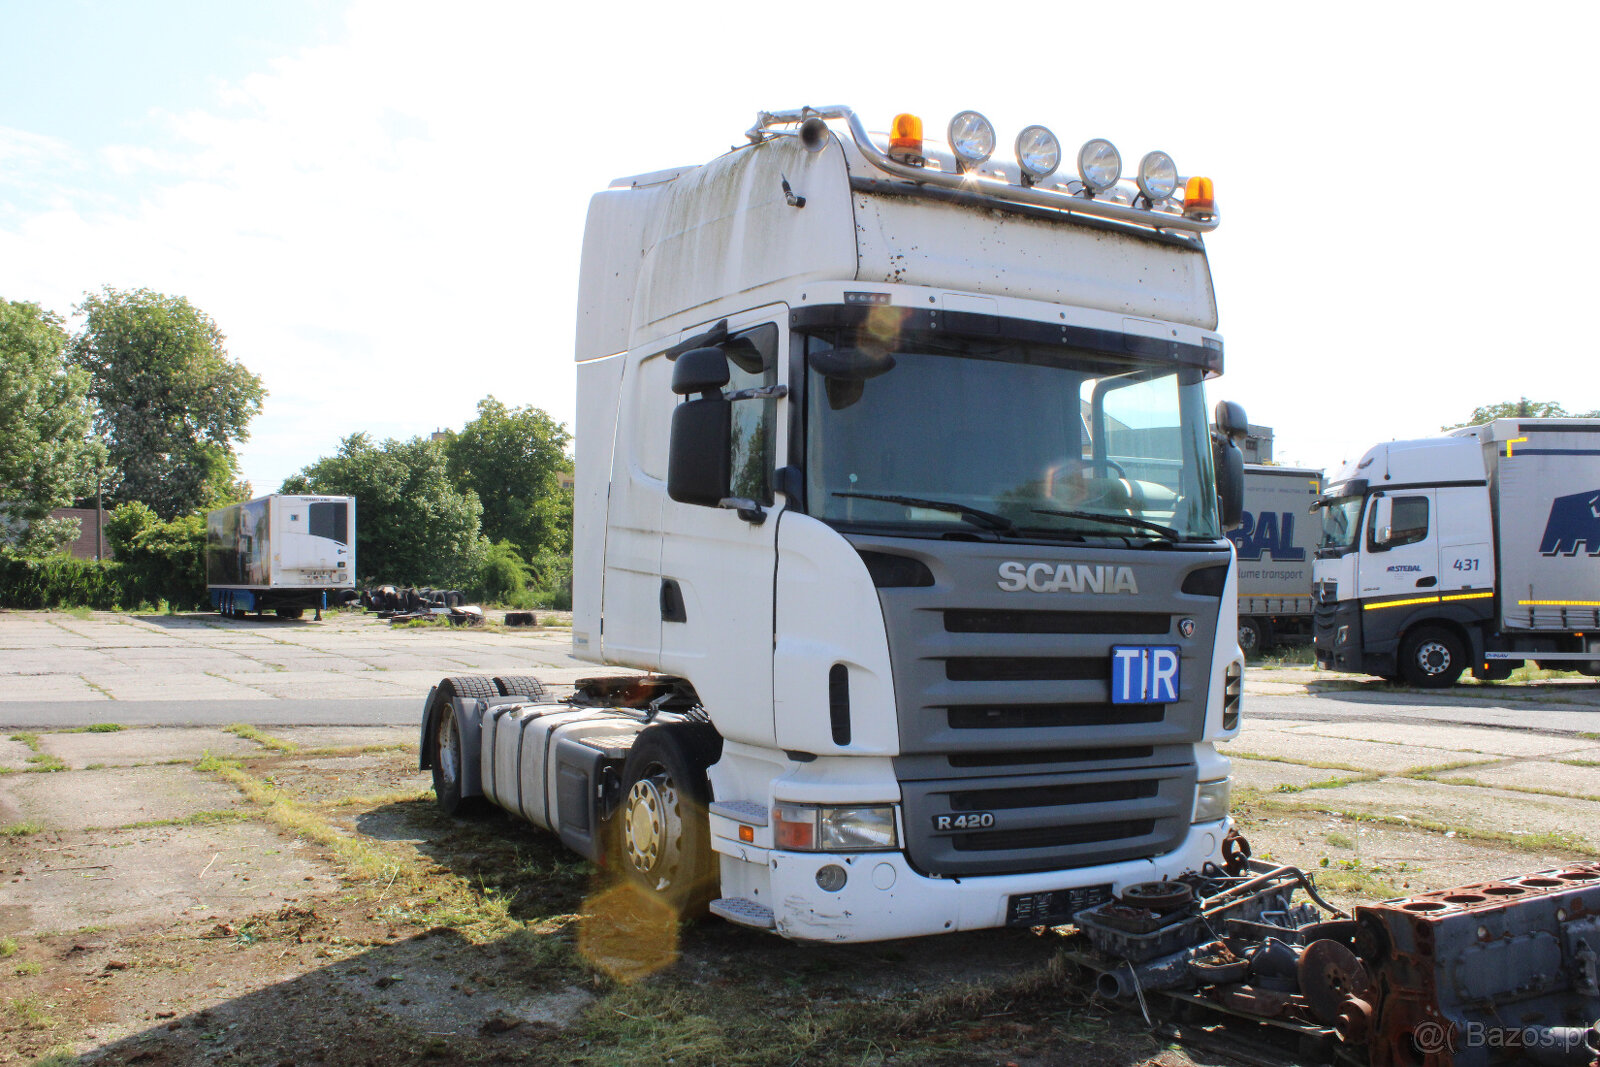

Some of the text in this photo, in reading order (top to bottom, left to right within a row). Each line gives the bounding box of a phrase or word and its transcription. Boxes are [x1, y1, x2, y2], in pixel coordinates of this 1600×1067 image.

[1453, 558, 1480, 571] 431
[997, 561, 1138, 594] SCANIA
[1262, 568, 1304, 581] transport
[1114, 649, 1178, 701] TIR
[938, 813, 994, 830] R 420
